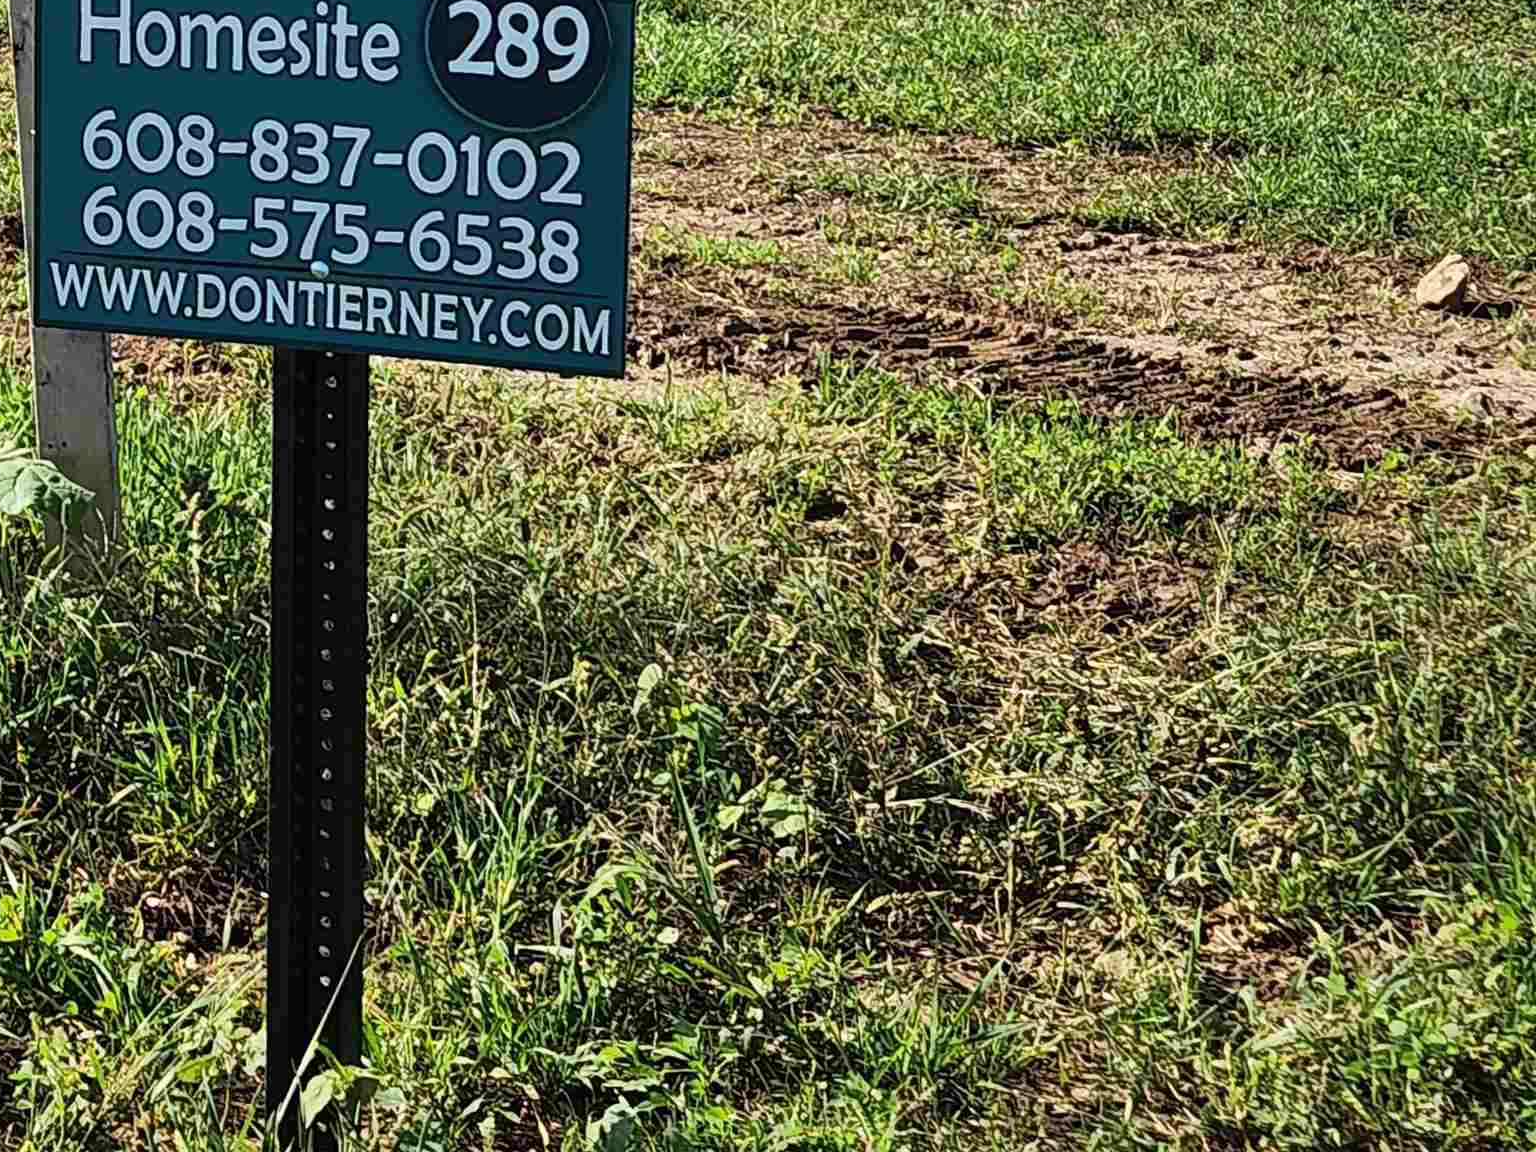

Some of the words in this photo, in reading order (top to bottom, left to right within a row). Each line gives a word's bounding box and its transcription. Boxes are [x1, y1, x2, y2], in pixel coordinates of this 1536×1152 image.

[81, 109, 584, 207] 608-837-0102
[81, 185, 581, 285] 608-575-6538
[49, 261, 612, 356] WWW.DONTIERNEY.COM
